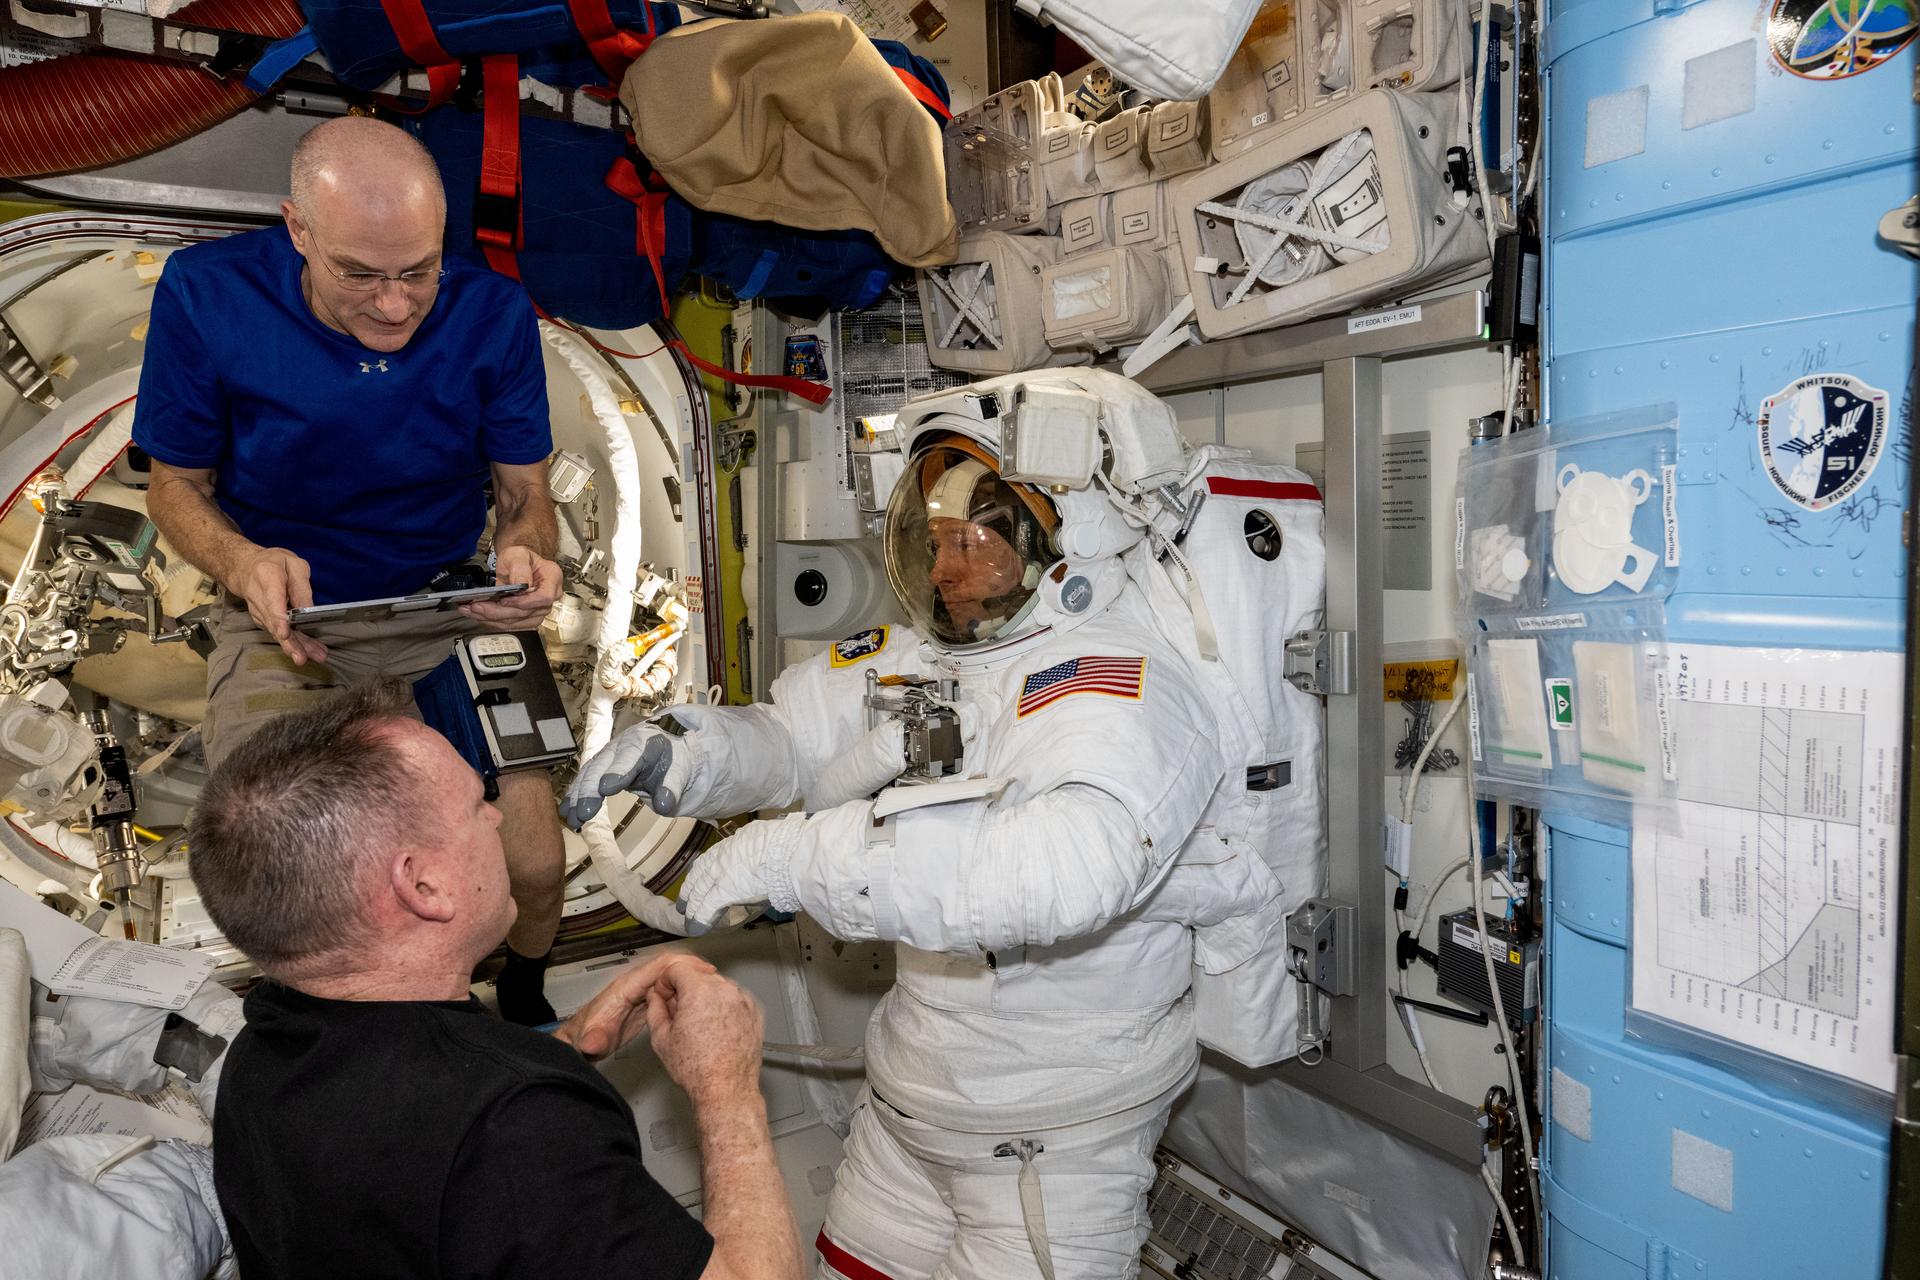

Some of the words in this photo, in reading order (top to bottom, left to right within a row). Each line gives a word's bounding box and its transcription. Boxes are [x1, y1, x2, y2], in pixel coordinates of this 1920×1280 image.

[1255, 116, 1262, 124] EV
[1354, 320, 1364, 328] AFT
[1796, 376, 1850, 390] WHITSON
[1868, 407, 1884, 458] ЮРЧИХИН
[1827, 456, 1856, 470] 51
[1768, 466, 1806, 504] НОВИЦКИЙ
[1828, 469, 1867, 503] FISCHER
